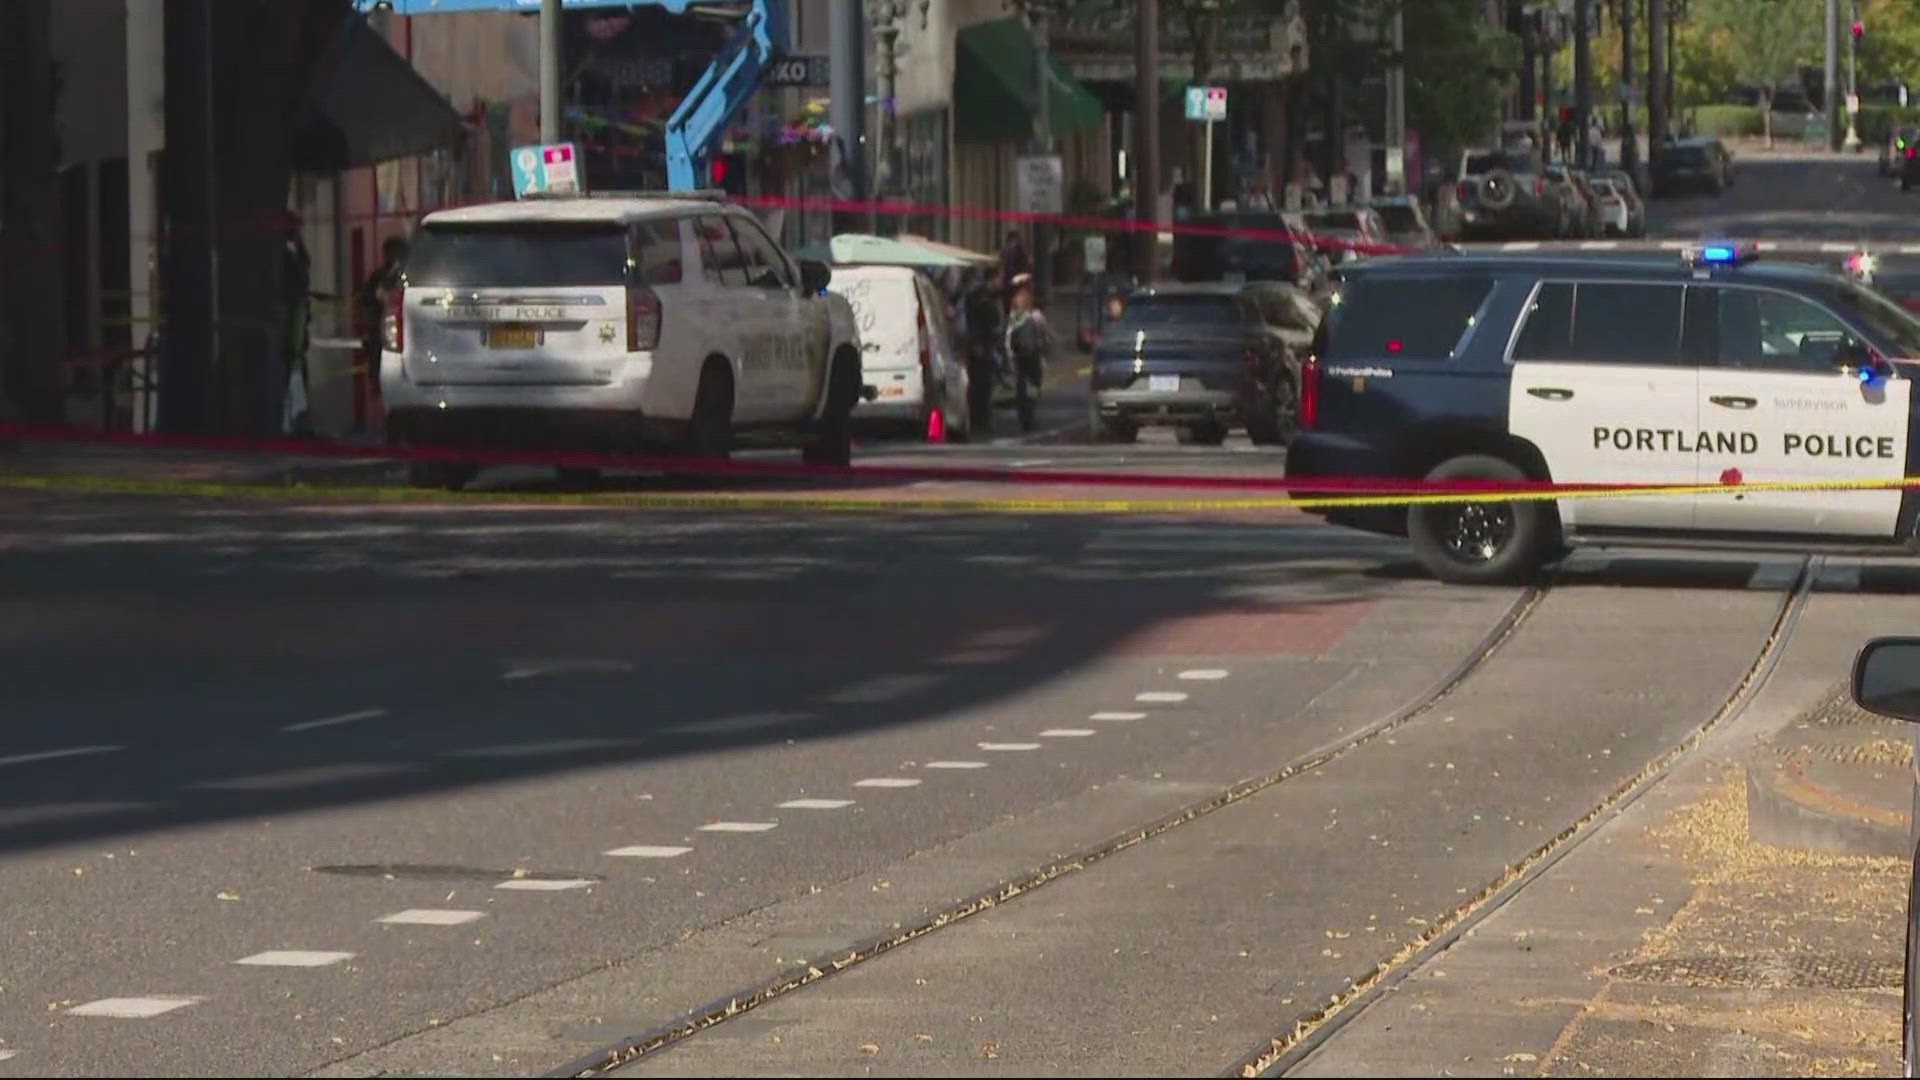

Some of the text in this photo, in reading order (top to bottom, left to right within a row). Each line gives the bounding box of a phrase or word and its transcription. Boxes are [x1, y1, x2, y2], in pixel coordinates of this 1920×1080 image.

[516, 307, 567, 319] POLICE
[1773, 397, 1848, 411] SUPERVISOR
[1592, 425, 1895, 459] PORTLAND POLICE
